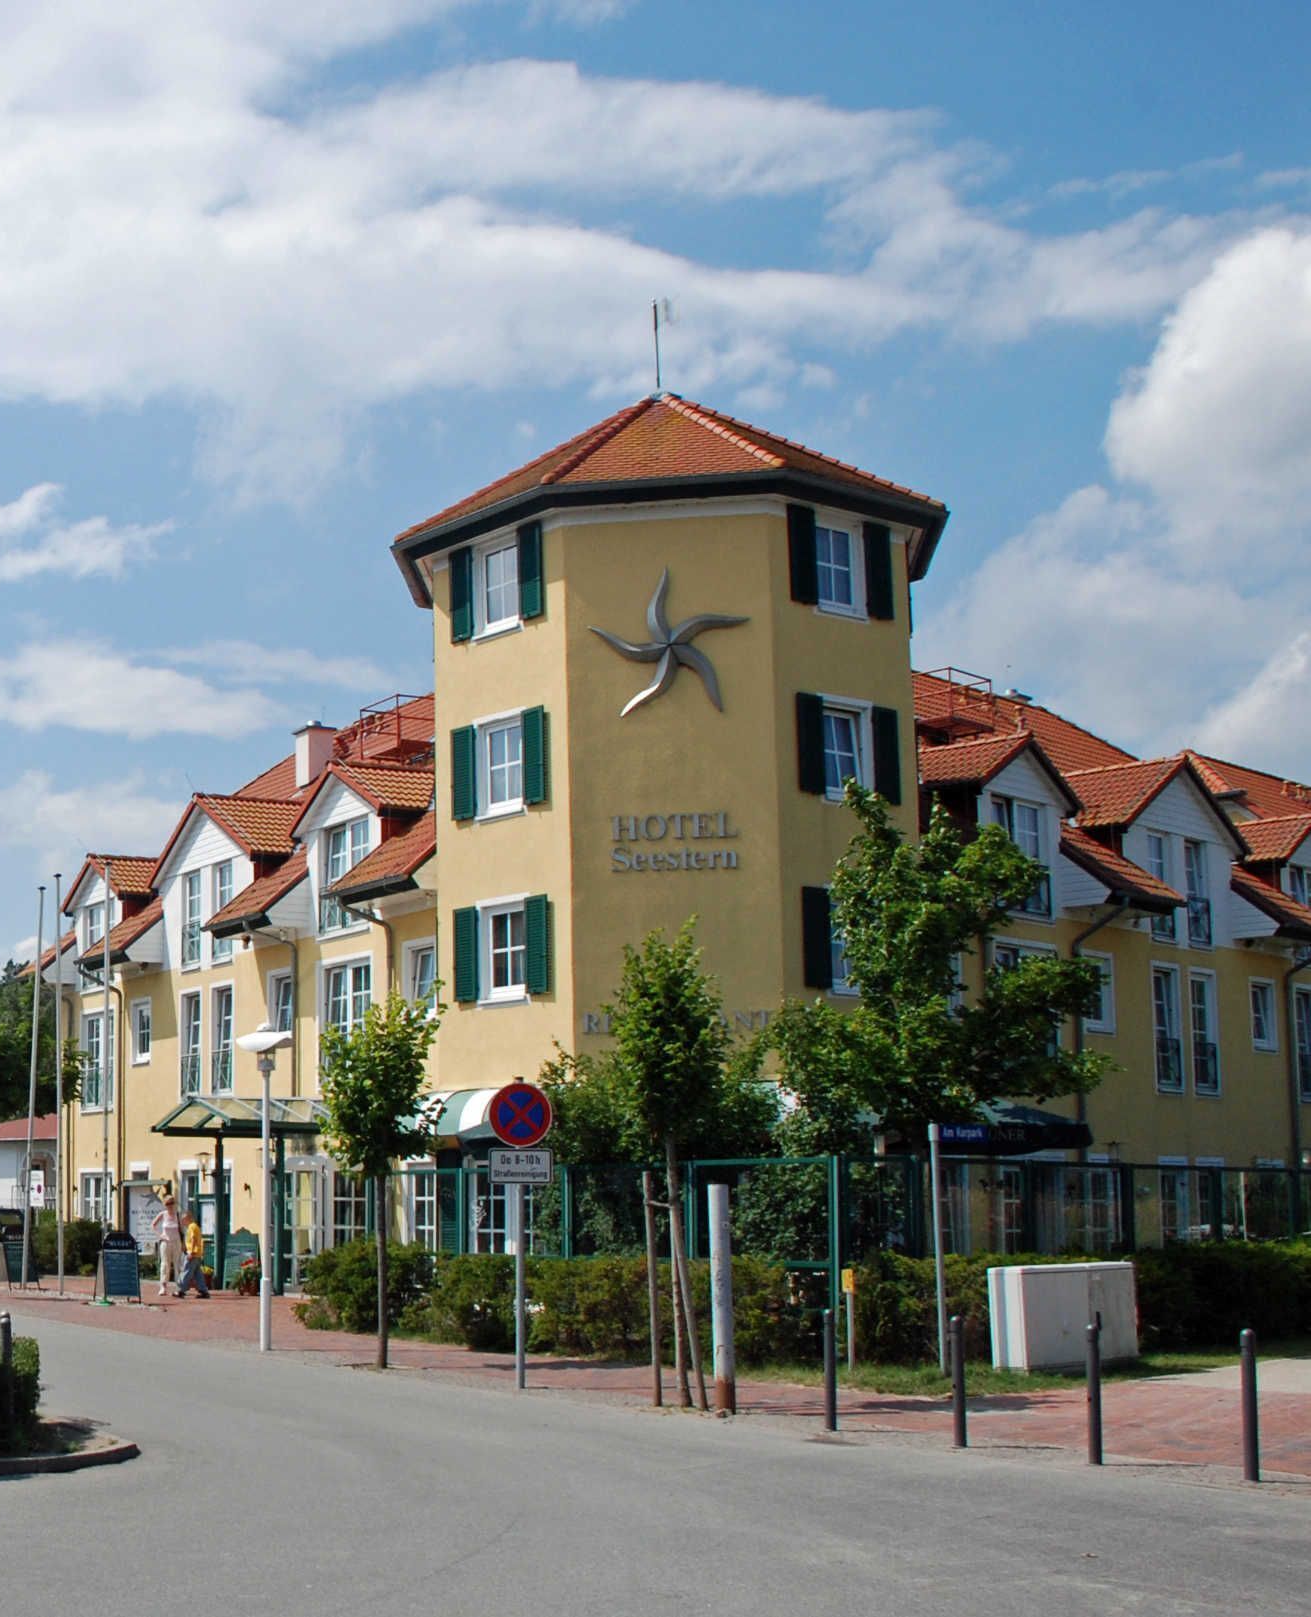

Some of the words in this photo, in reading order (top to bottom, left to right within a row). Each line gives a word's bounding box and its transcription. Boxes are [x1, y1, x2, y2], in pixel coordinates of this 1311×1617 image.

[610, 810, 738, 842] HOTEL
[610, 846, 738, 873] Seestern
[942, 1125, 955, 1138] Am
[956, 1125, 983, 1141] Kurpark
